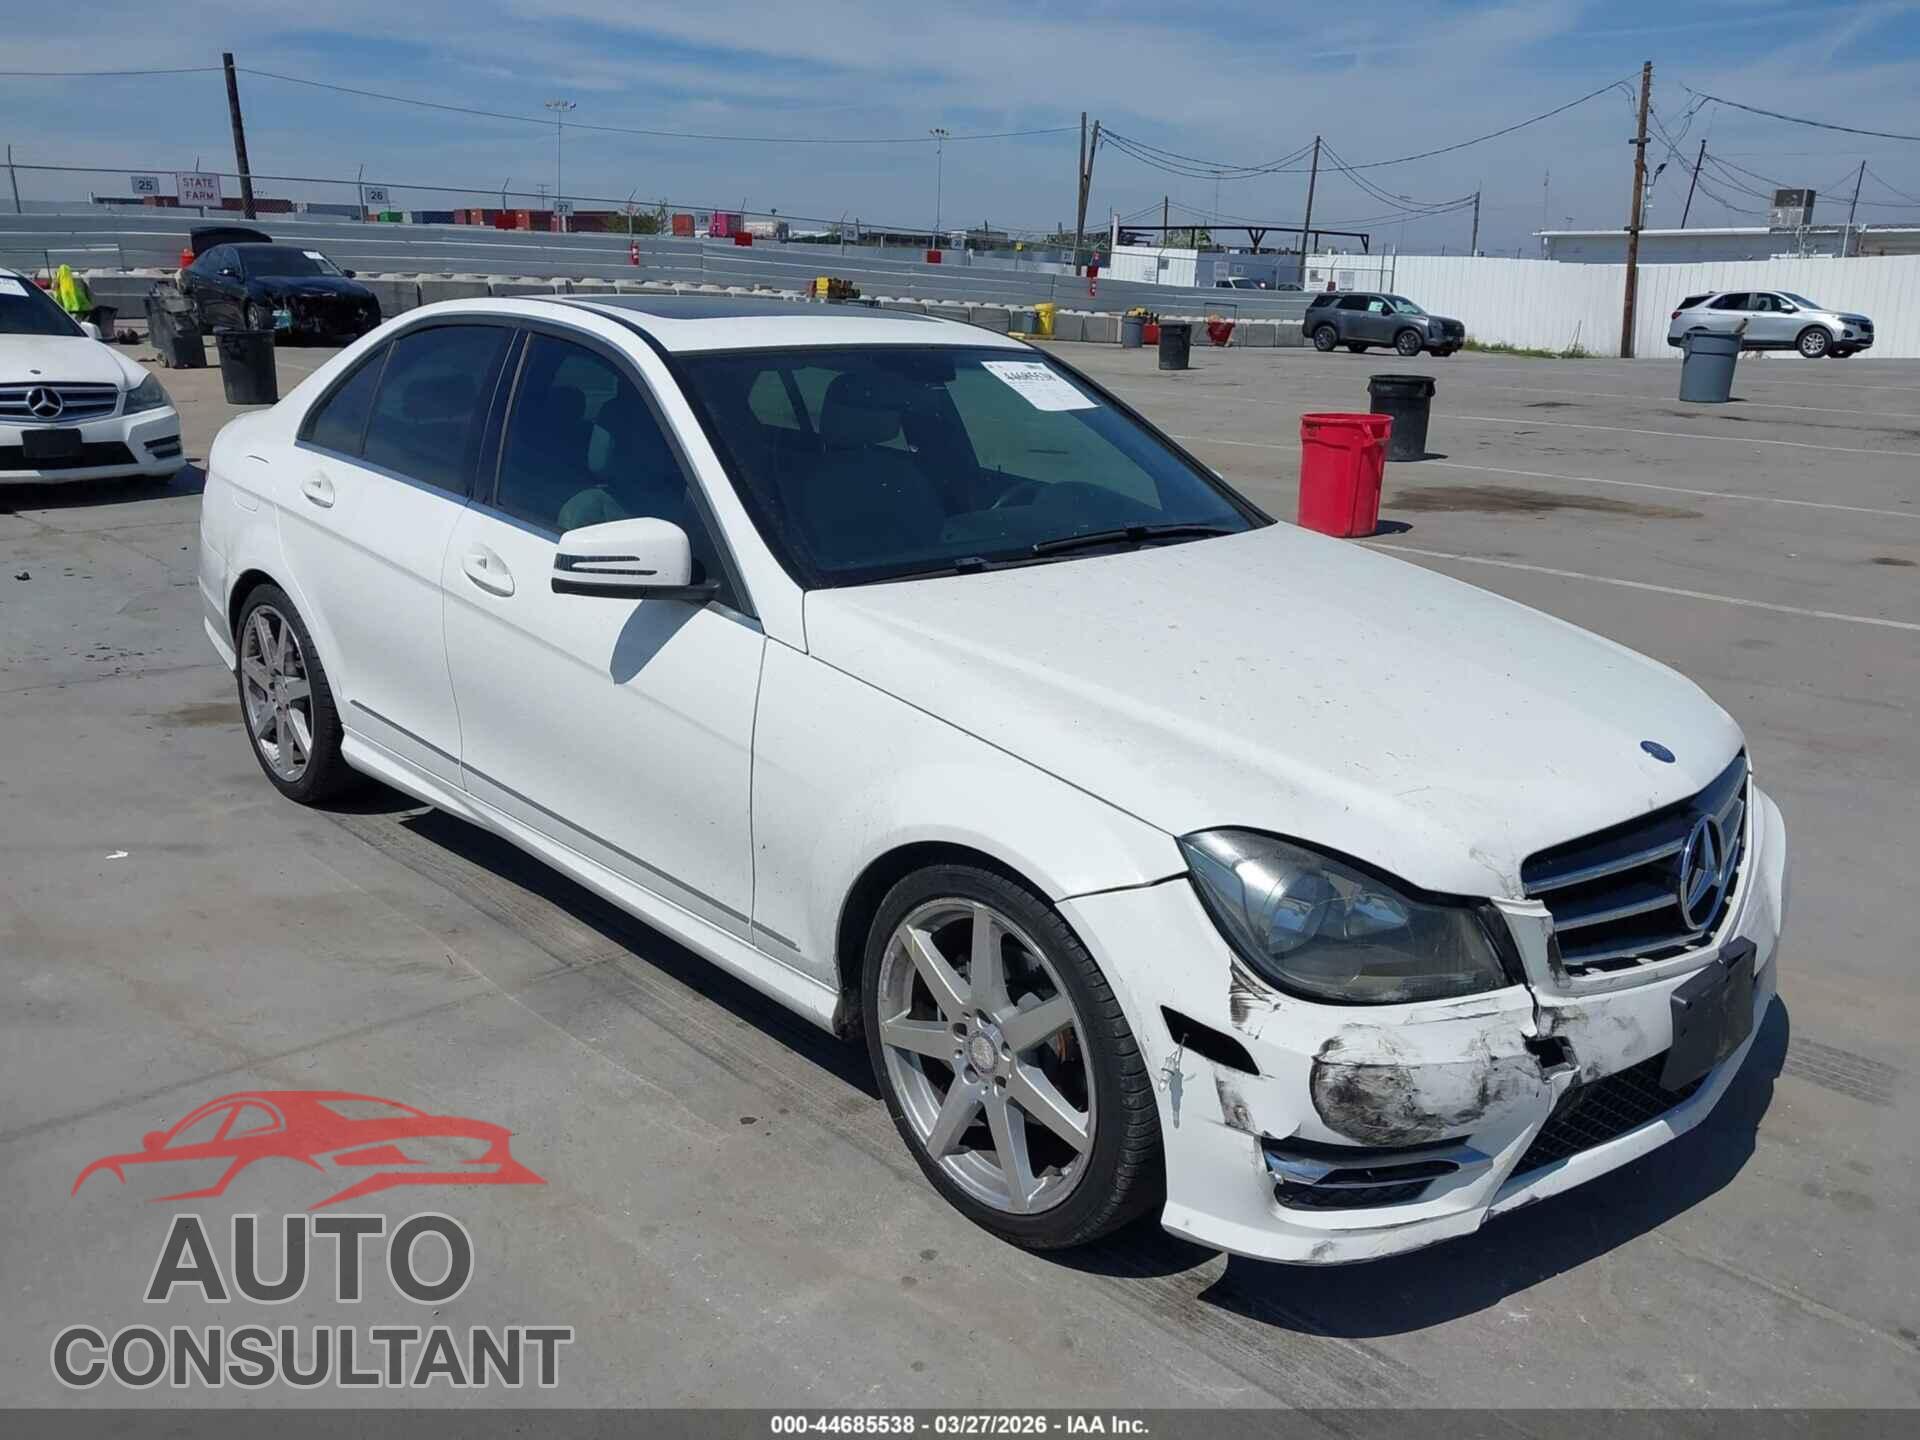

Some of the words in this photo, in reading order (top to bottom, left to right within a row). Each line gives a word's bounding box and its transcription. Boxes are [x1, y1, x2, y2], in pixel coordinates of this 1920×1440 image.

[139, 179, 153, 190] 25
[182, 177, 214, 188] STATE
[185, 190, 214, 201] FARM
[370, 191, 384, 200] 26
